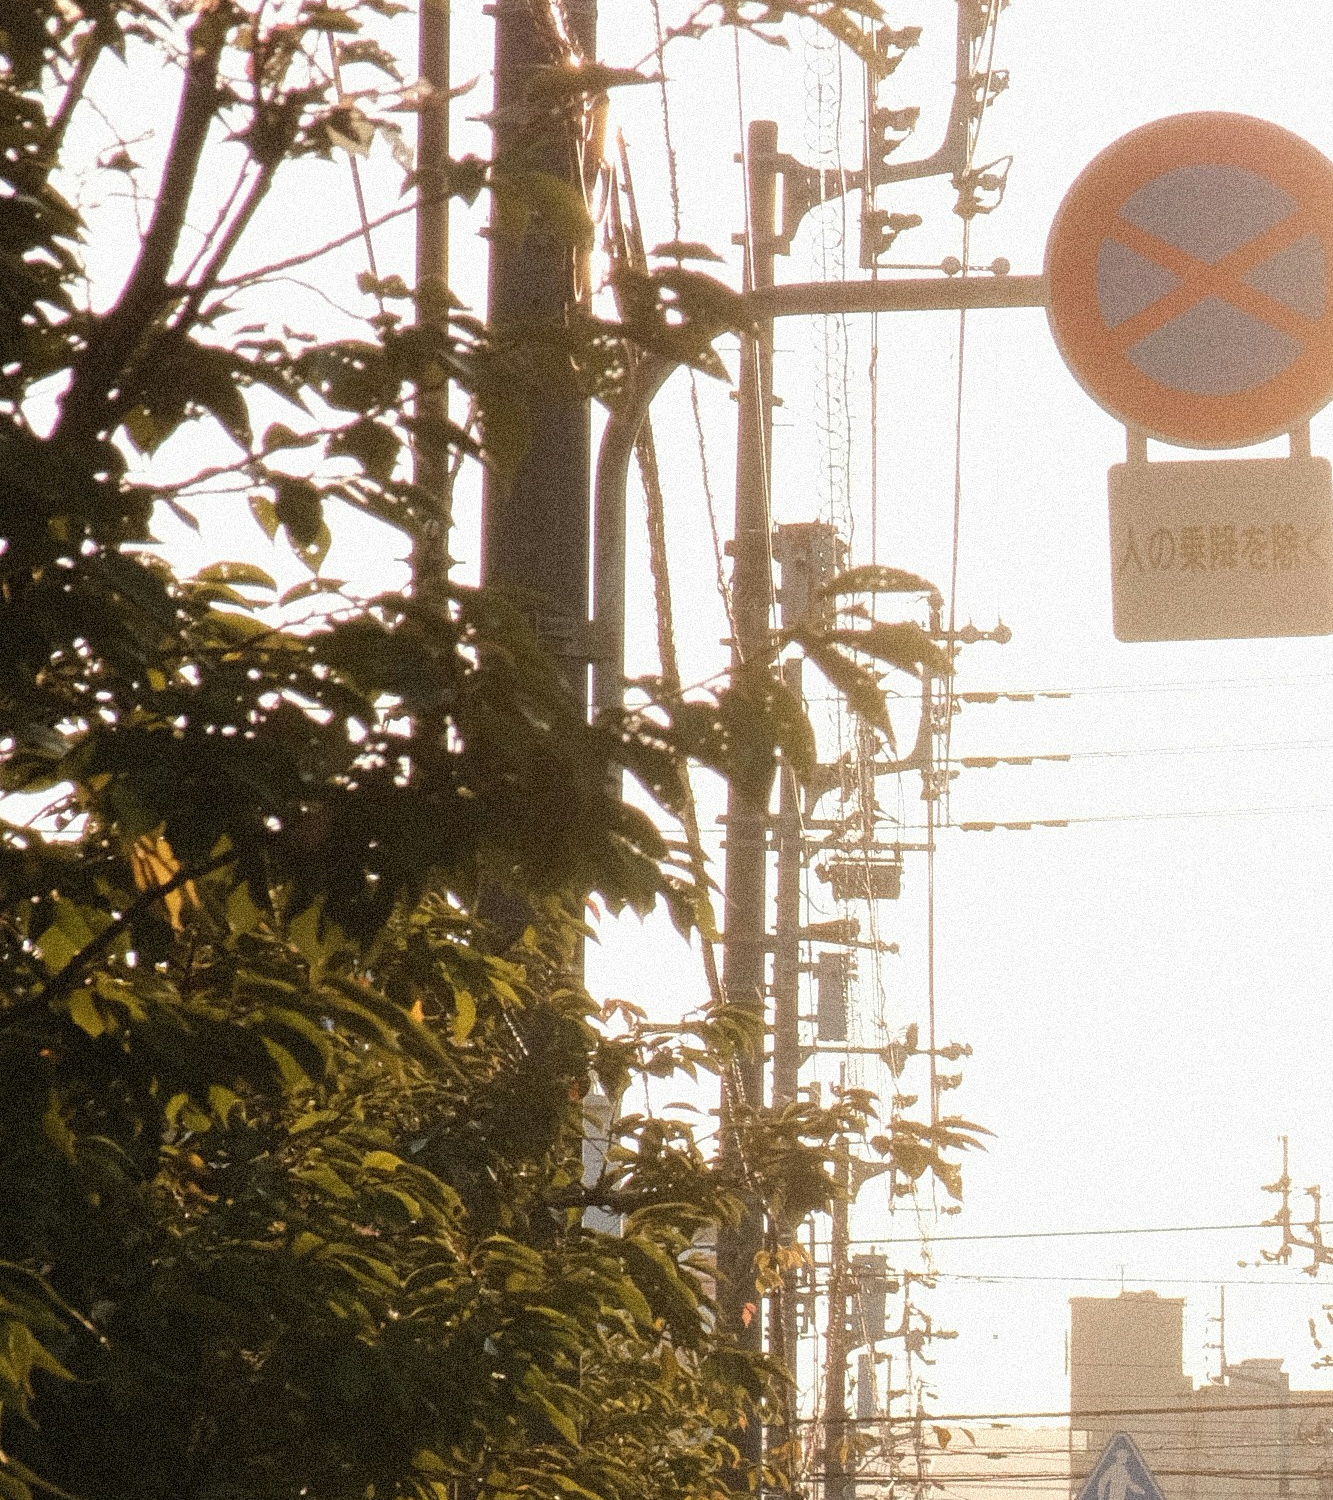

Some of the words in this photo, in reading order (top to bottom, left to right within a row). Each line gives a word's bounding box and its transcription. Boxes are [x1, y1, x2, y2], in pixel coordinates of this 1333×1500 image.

[1118, 522, 1327, 575] 人の乗降を除く
